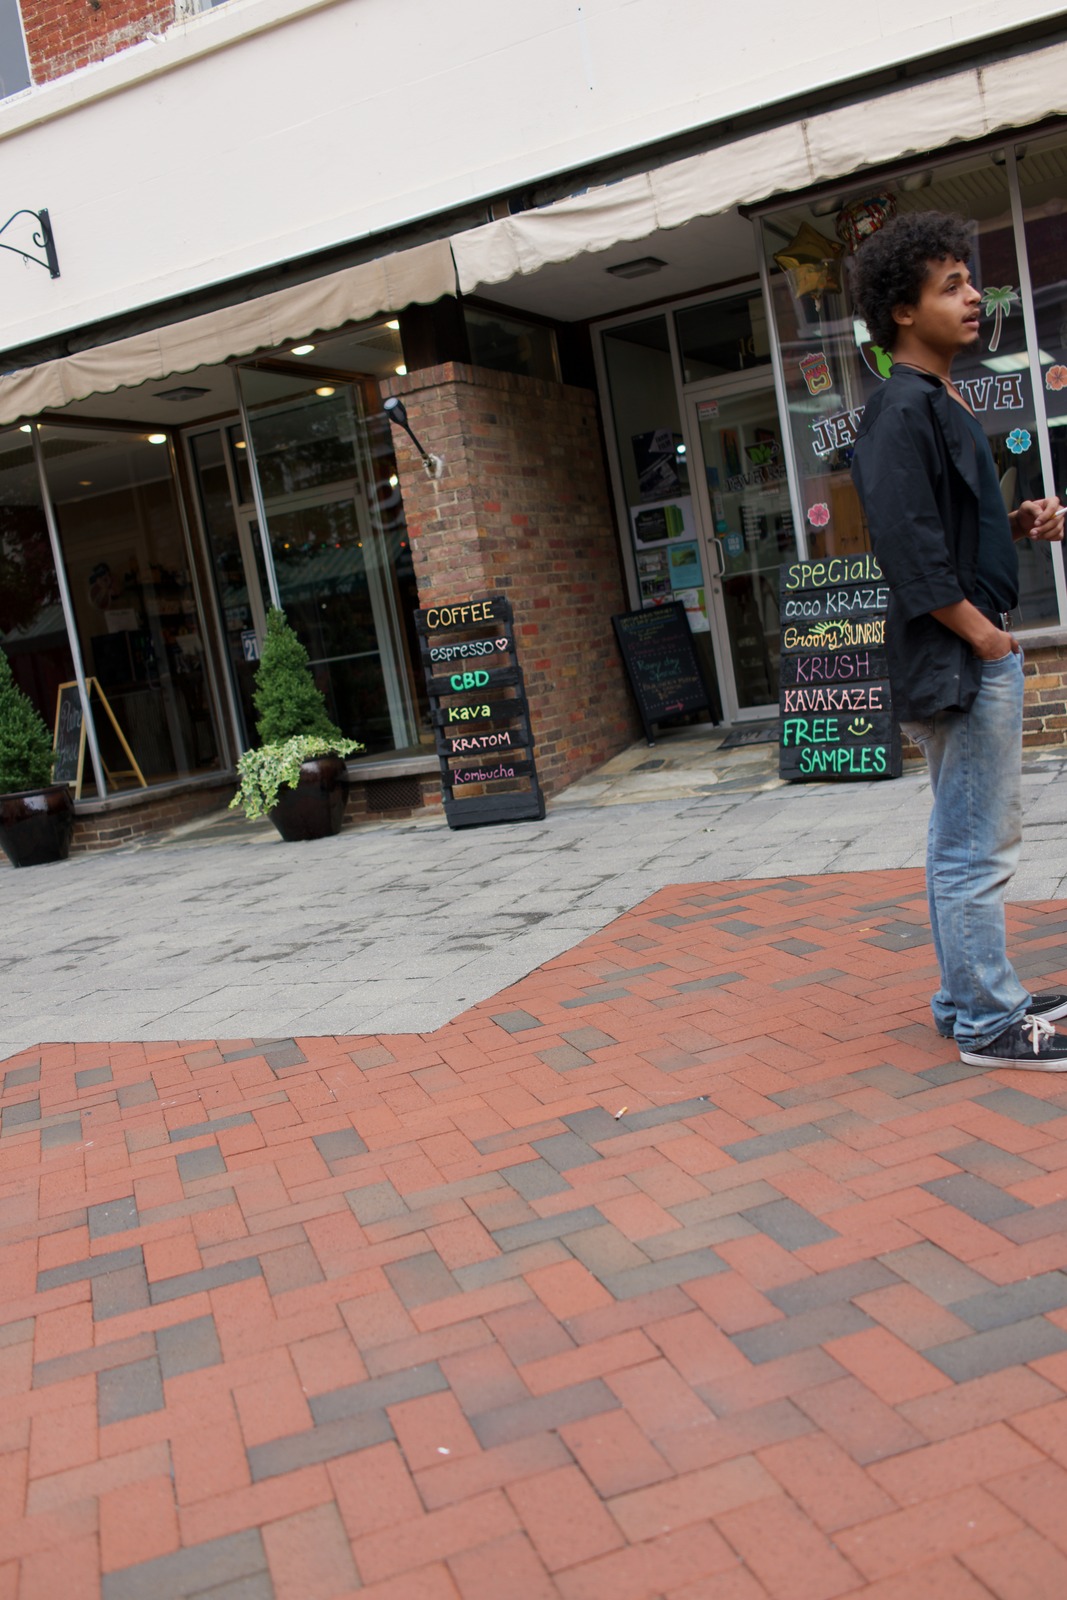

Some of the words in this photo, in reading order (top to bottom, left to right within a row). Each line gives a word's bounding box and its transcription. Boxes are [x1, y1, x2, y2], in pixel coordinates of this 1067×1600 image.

[826, 587, 890, 615] KRAZE
[426, 601, 495, 629] COFFEE
[784, 627, 843, 651] Groovy
[843, 620, 886, 646] SUNRISE
[430, 641, 495, 662] espresso
[450, 670, 490, 692] CBD
[796, 652, 870, 683] KRUSH
[784, 686, 883, 713] KAVAKAZE
[452, 731, 511, 752] KRATOM
[783, 718, 841, 747] FREE
[799, 747, 887, 774] SAMPLES
[454, 764, 515, 785] Kombucha
